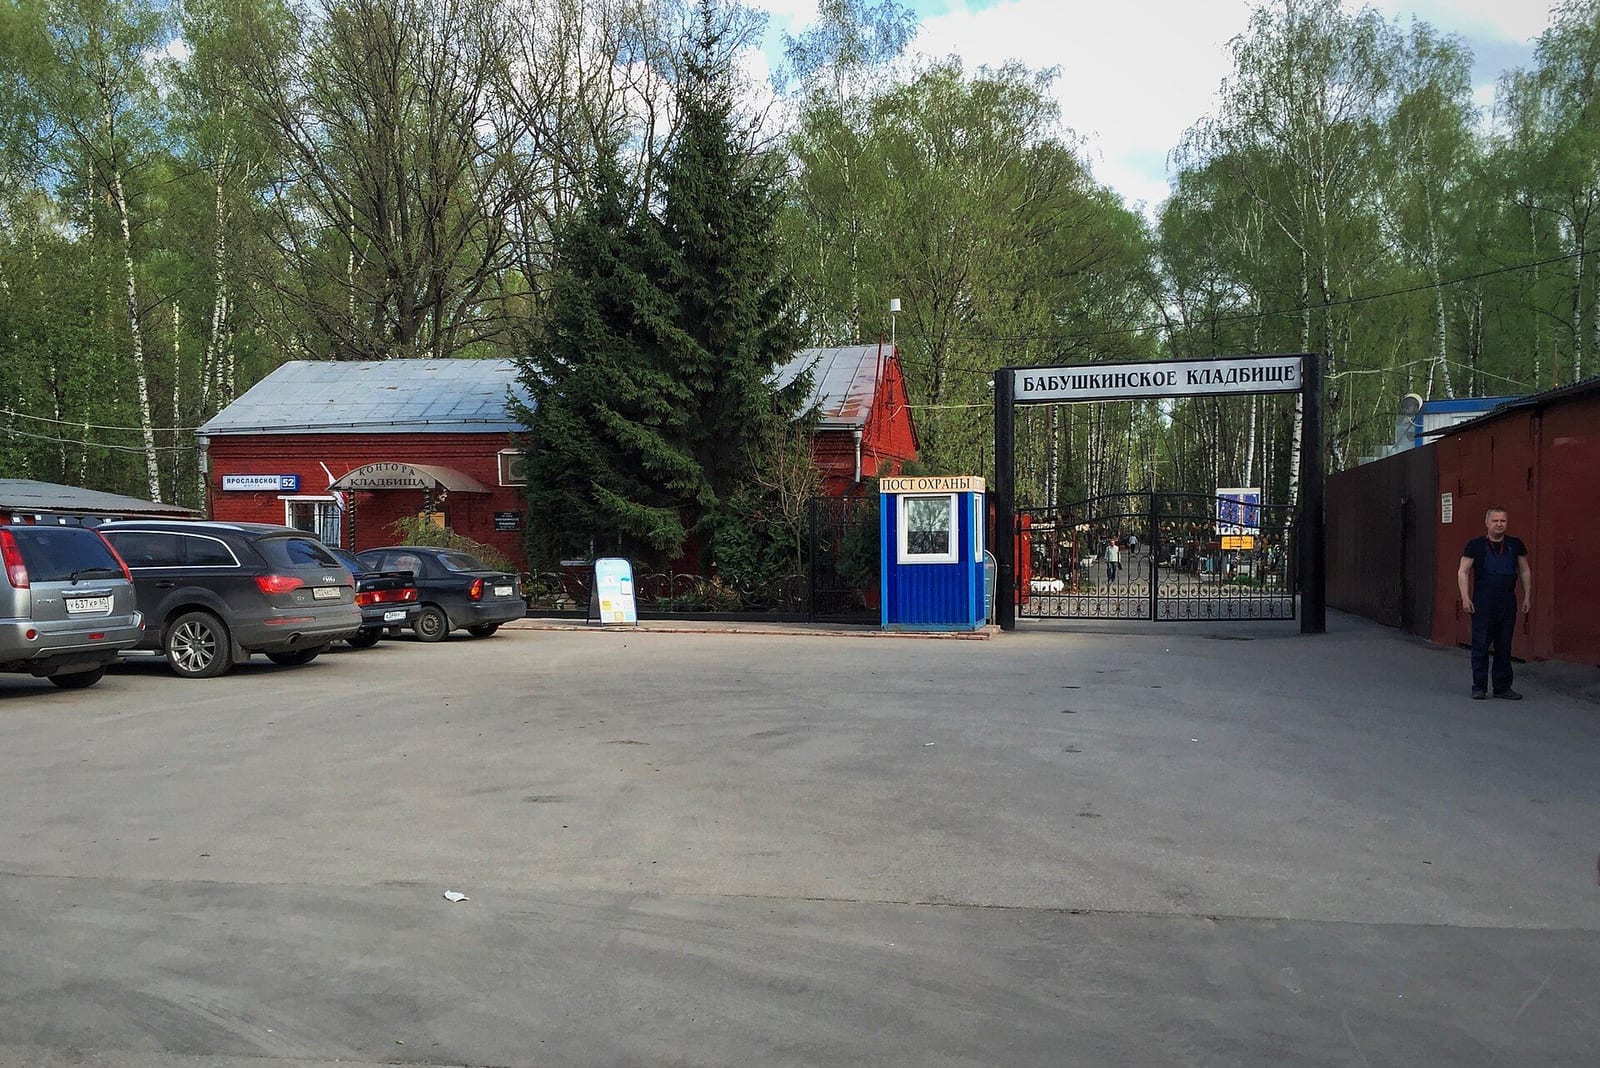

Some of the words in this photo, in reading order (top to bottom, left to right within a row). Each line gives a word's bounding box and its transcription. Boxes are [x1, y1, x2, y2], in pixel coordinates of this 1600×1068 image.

[1023, 370, 1177, 392] БАБУШКИНСКОЕ
[1187, 365, 1295, 387] КЛАДБИЩЕ
[359, 463, 415, 476] КОНТОРА
[282, 478, 295, 487] 52
[350, 479, 425, 487] КЛАДБИЩА
[882, 479, 915, 490] ПОСТ
[918, 478, 970, 489] ОХРАНЫ
